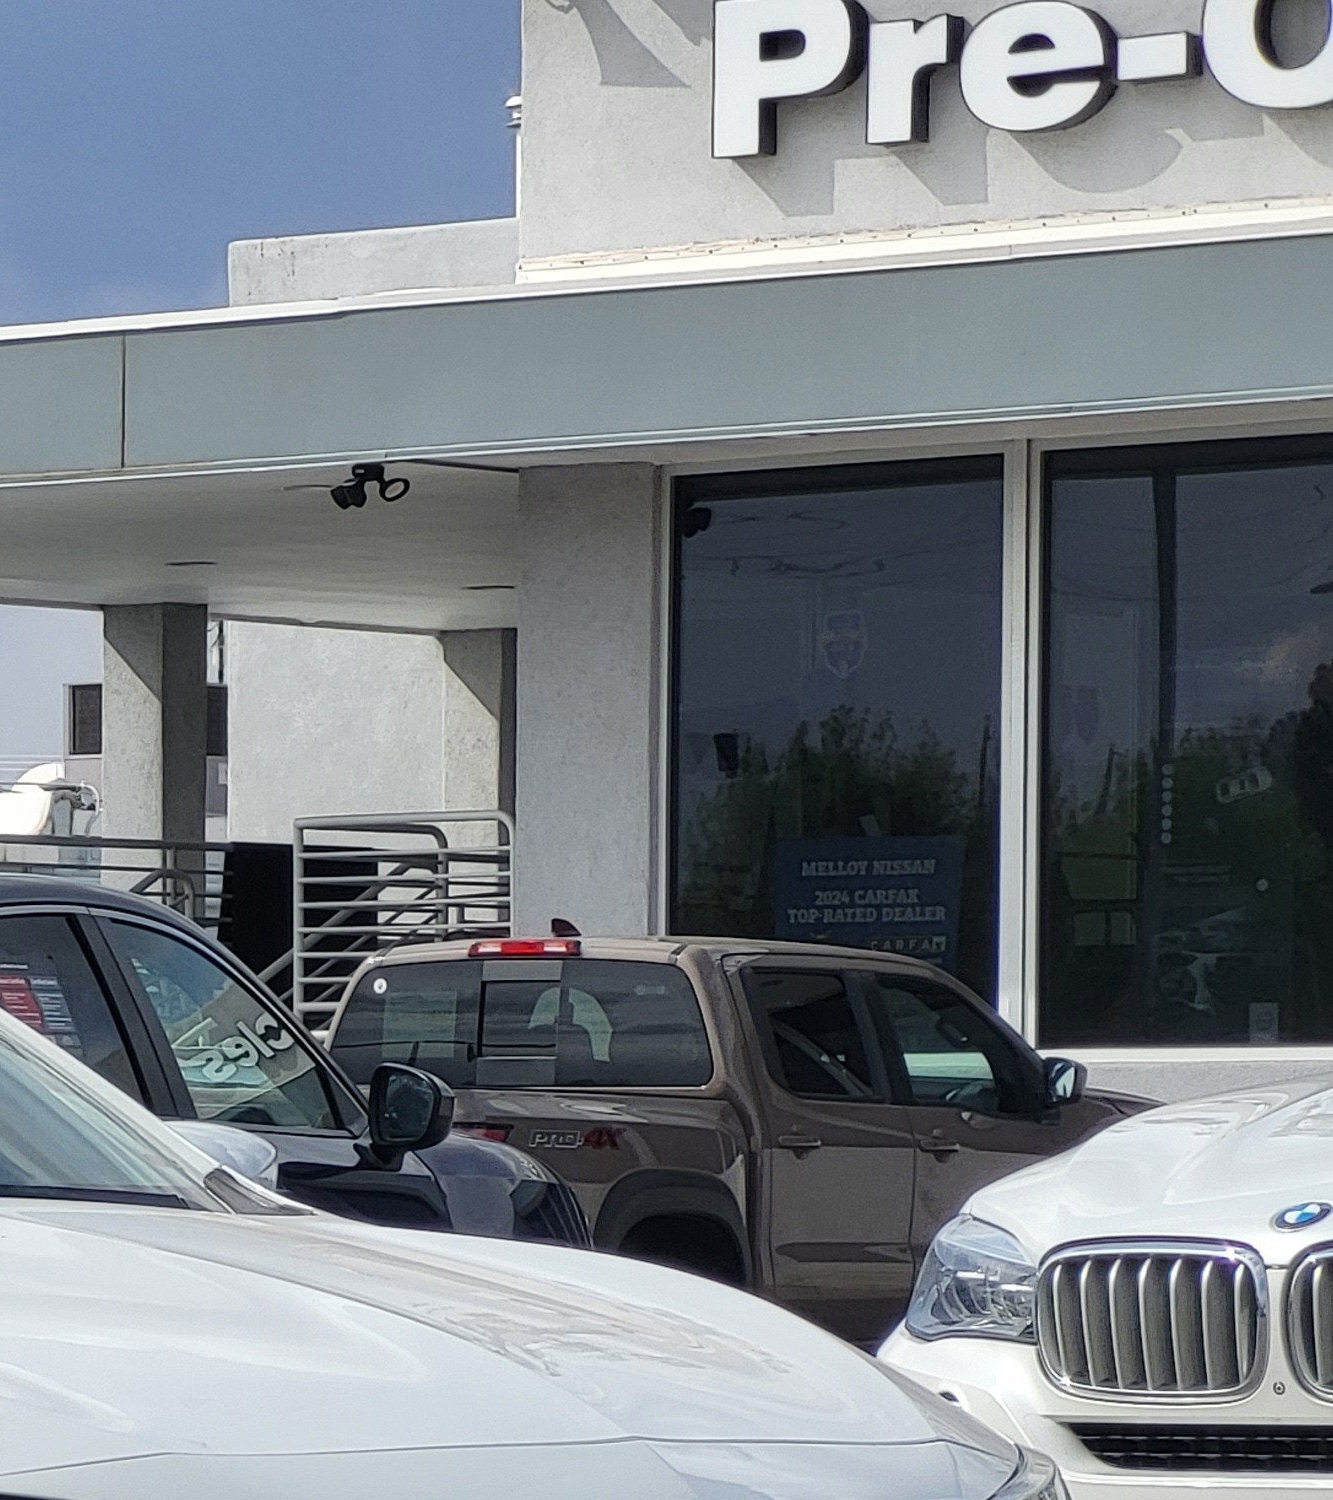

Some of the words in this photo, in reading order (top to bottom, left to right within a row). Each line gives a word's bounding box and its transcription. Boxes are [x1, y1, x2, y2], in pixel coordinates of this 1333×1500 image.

[802, 860, 868, 876] MELLOY
[873, 859, 936, 874] NISSAN
[815, 891, 850, 905] 2024
[855, 889, 919, 904] CARFAX
[788, 908, 876, 923] TOP-RATED
[882, 906, 945, 921] DEALER
